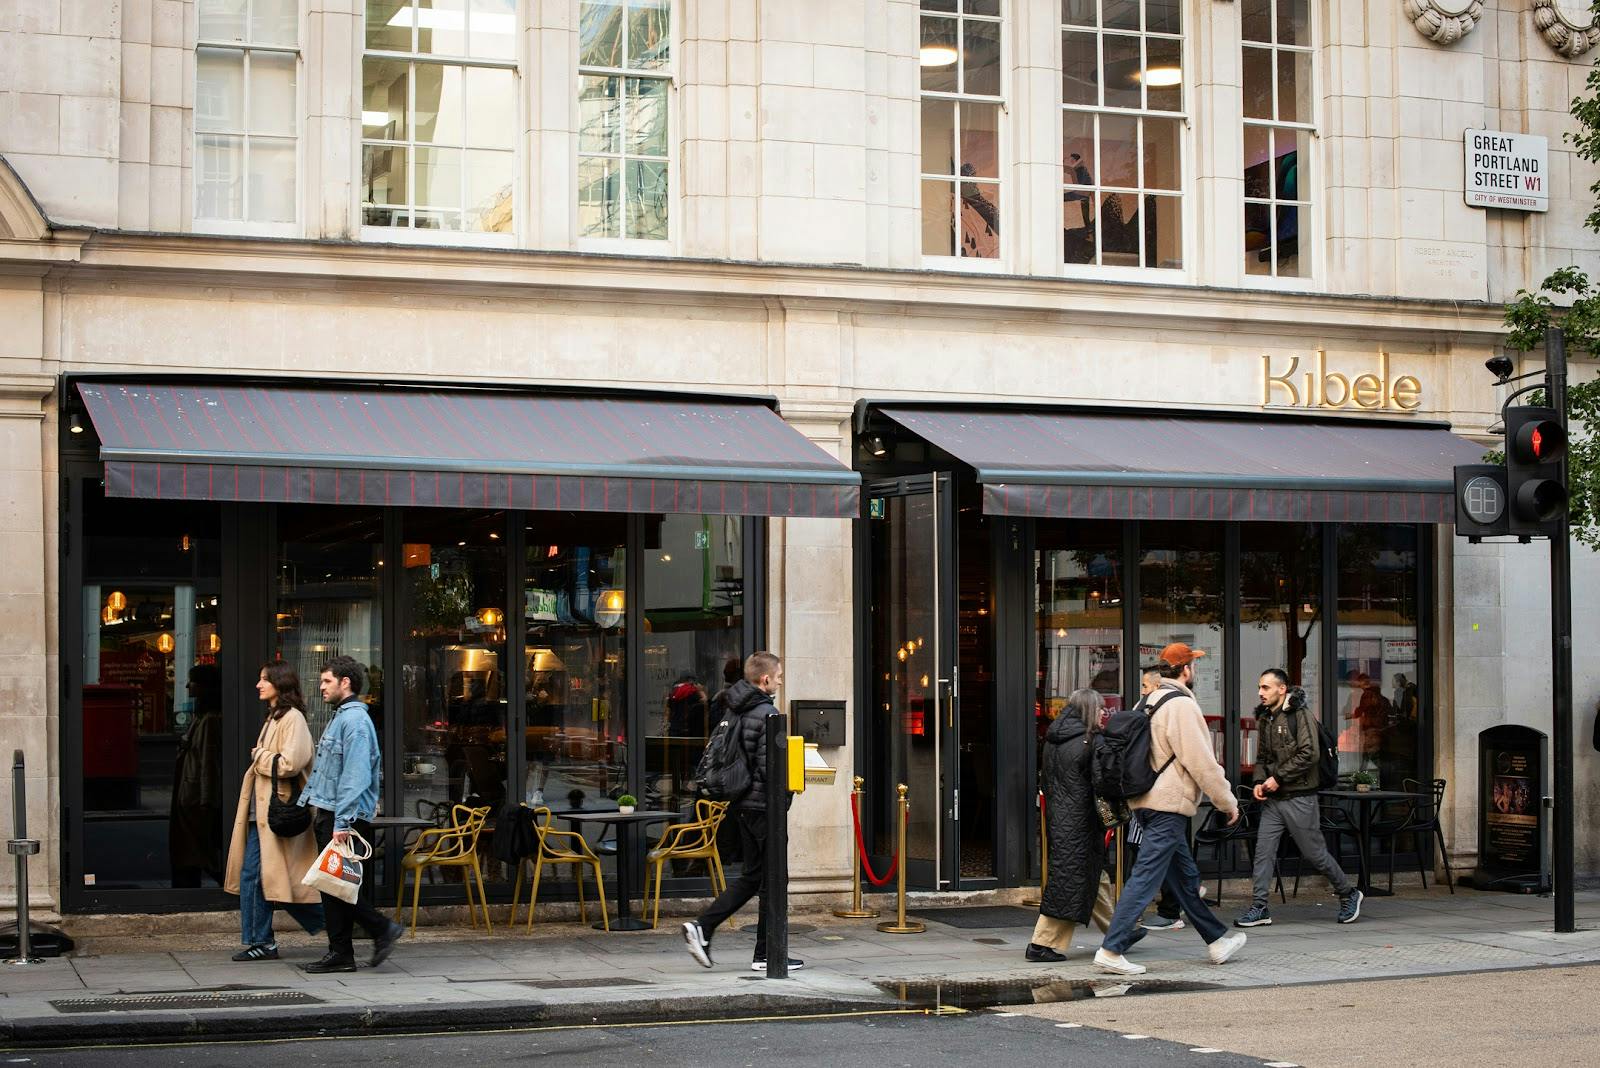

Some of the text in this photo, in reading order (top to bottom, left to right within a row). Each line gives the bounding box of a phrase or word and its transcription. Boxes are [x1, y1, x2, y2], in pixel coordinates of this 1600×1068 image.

[1474, 135, 1514, 153] GREAT
[1474, 153, 1539, 173] PORTLAND
[1475, 172, 1541, 191] STREET W1
[1489, 195, 1496, 203] OF
[1497, 197, 1537, 206] WESTMINSTER
[1262, 350, 1422, 409] Kibele
